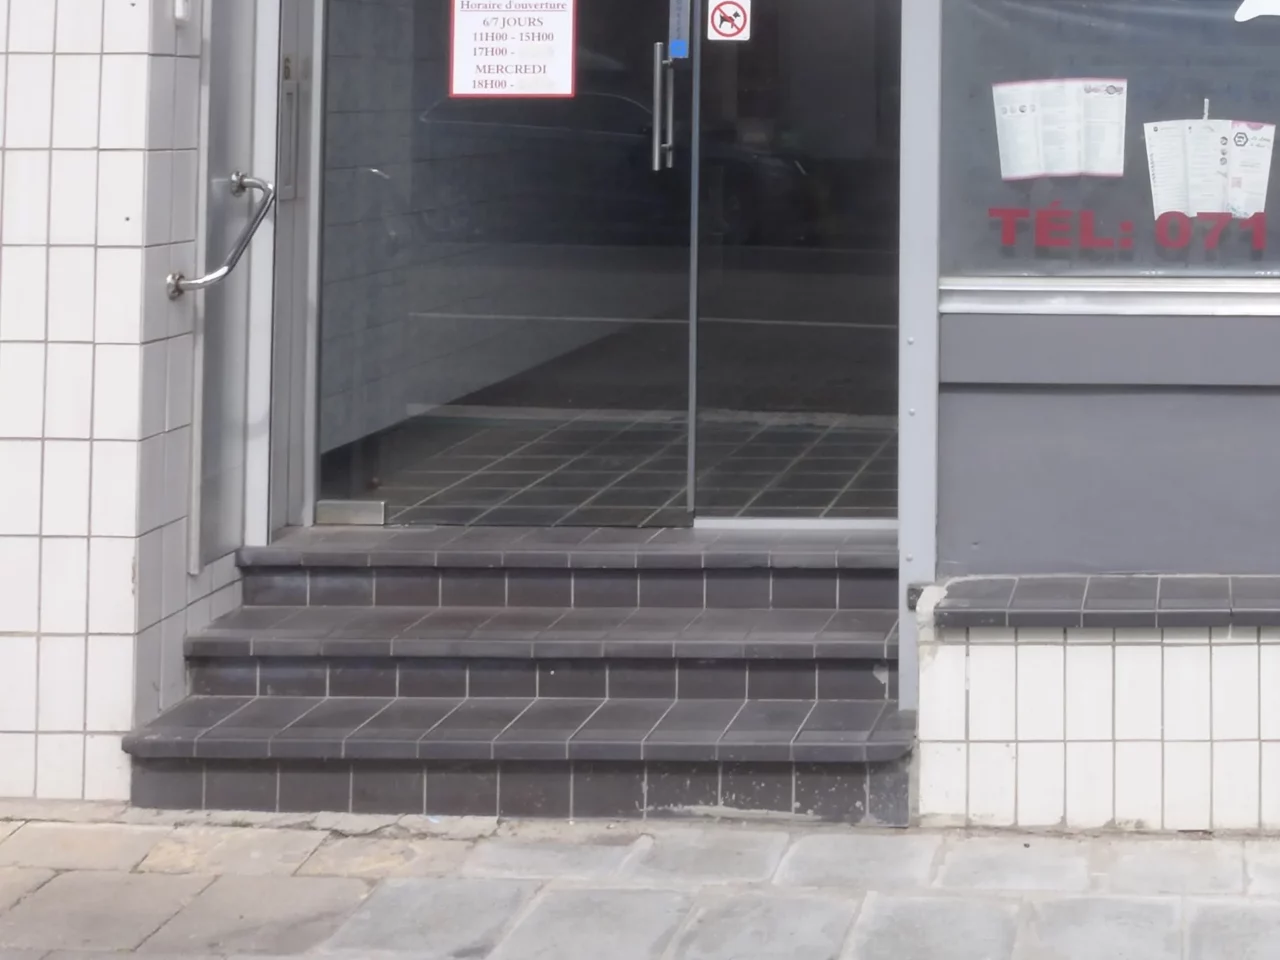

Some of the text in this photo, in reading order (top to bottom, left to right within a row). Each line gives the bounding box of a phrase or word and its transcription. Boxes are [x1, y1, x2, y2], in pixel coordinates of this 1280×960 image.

[460, 0, 567, 12] Horaire d'ouverture
[482, 17, 543, 29] 6/7 JOURS
[473, 32, 508, 42] 11H00
[519, 32, 554, 42] 15H00
[473, 47, 508, 57] 17H00
[475, 64, 547, 74] MERCREDI
[472, 80, 507, 89] 18H00
[989, 200, 1133, 249] TÉL:
[1155, 211, 1266, 249] 071
